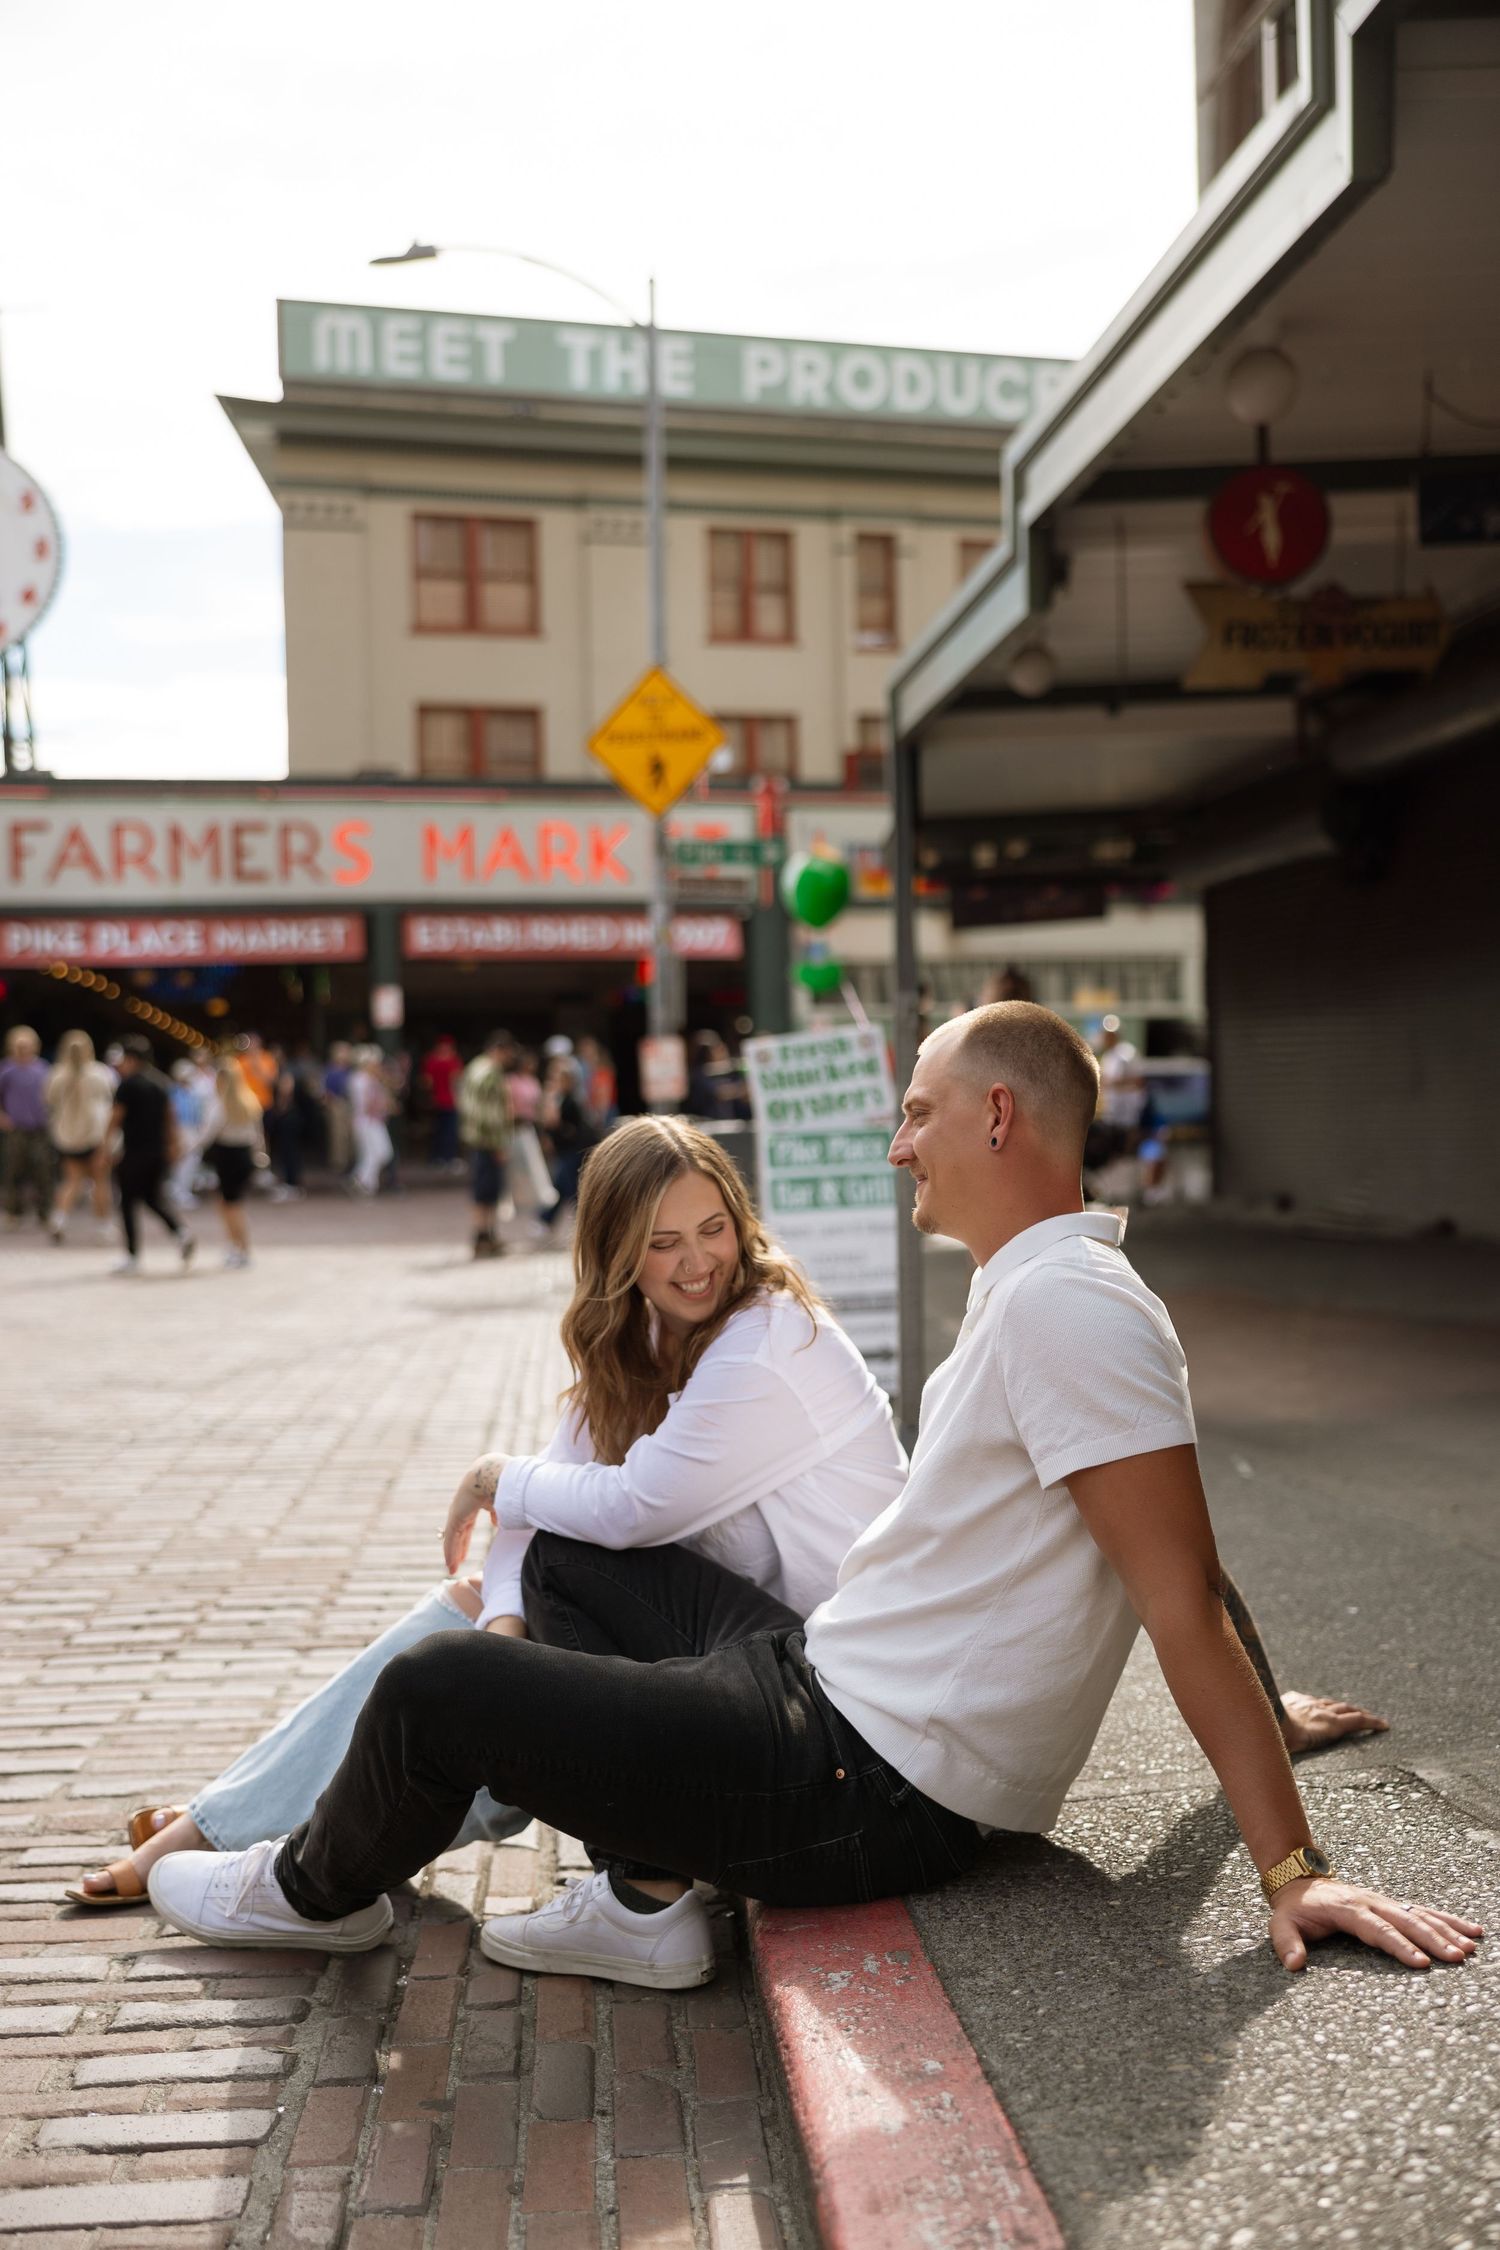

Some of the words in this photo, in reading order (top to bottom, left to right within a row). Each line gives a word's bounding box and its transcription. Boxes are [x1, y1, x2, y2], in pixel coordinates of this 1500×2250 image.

[312, 308, 517, 385] MEET
[557, 326, 696, 397] THE
[7, 818, 375, 887] FARMERS
[420, 820, 732, 884] MARK
[5, 918, 84, 958] PIKE
[91, 917, 204, 957] PLACE
[212, 916, 349, 953] MARKET
